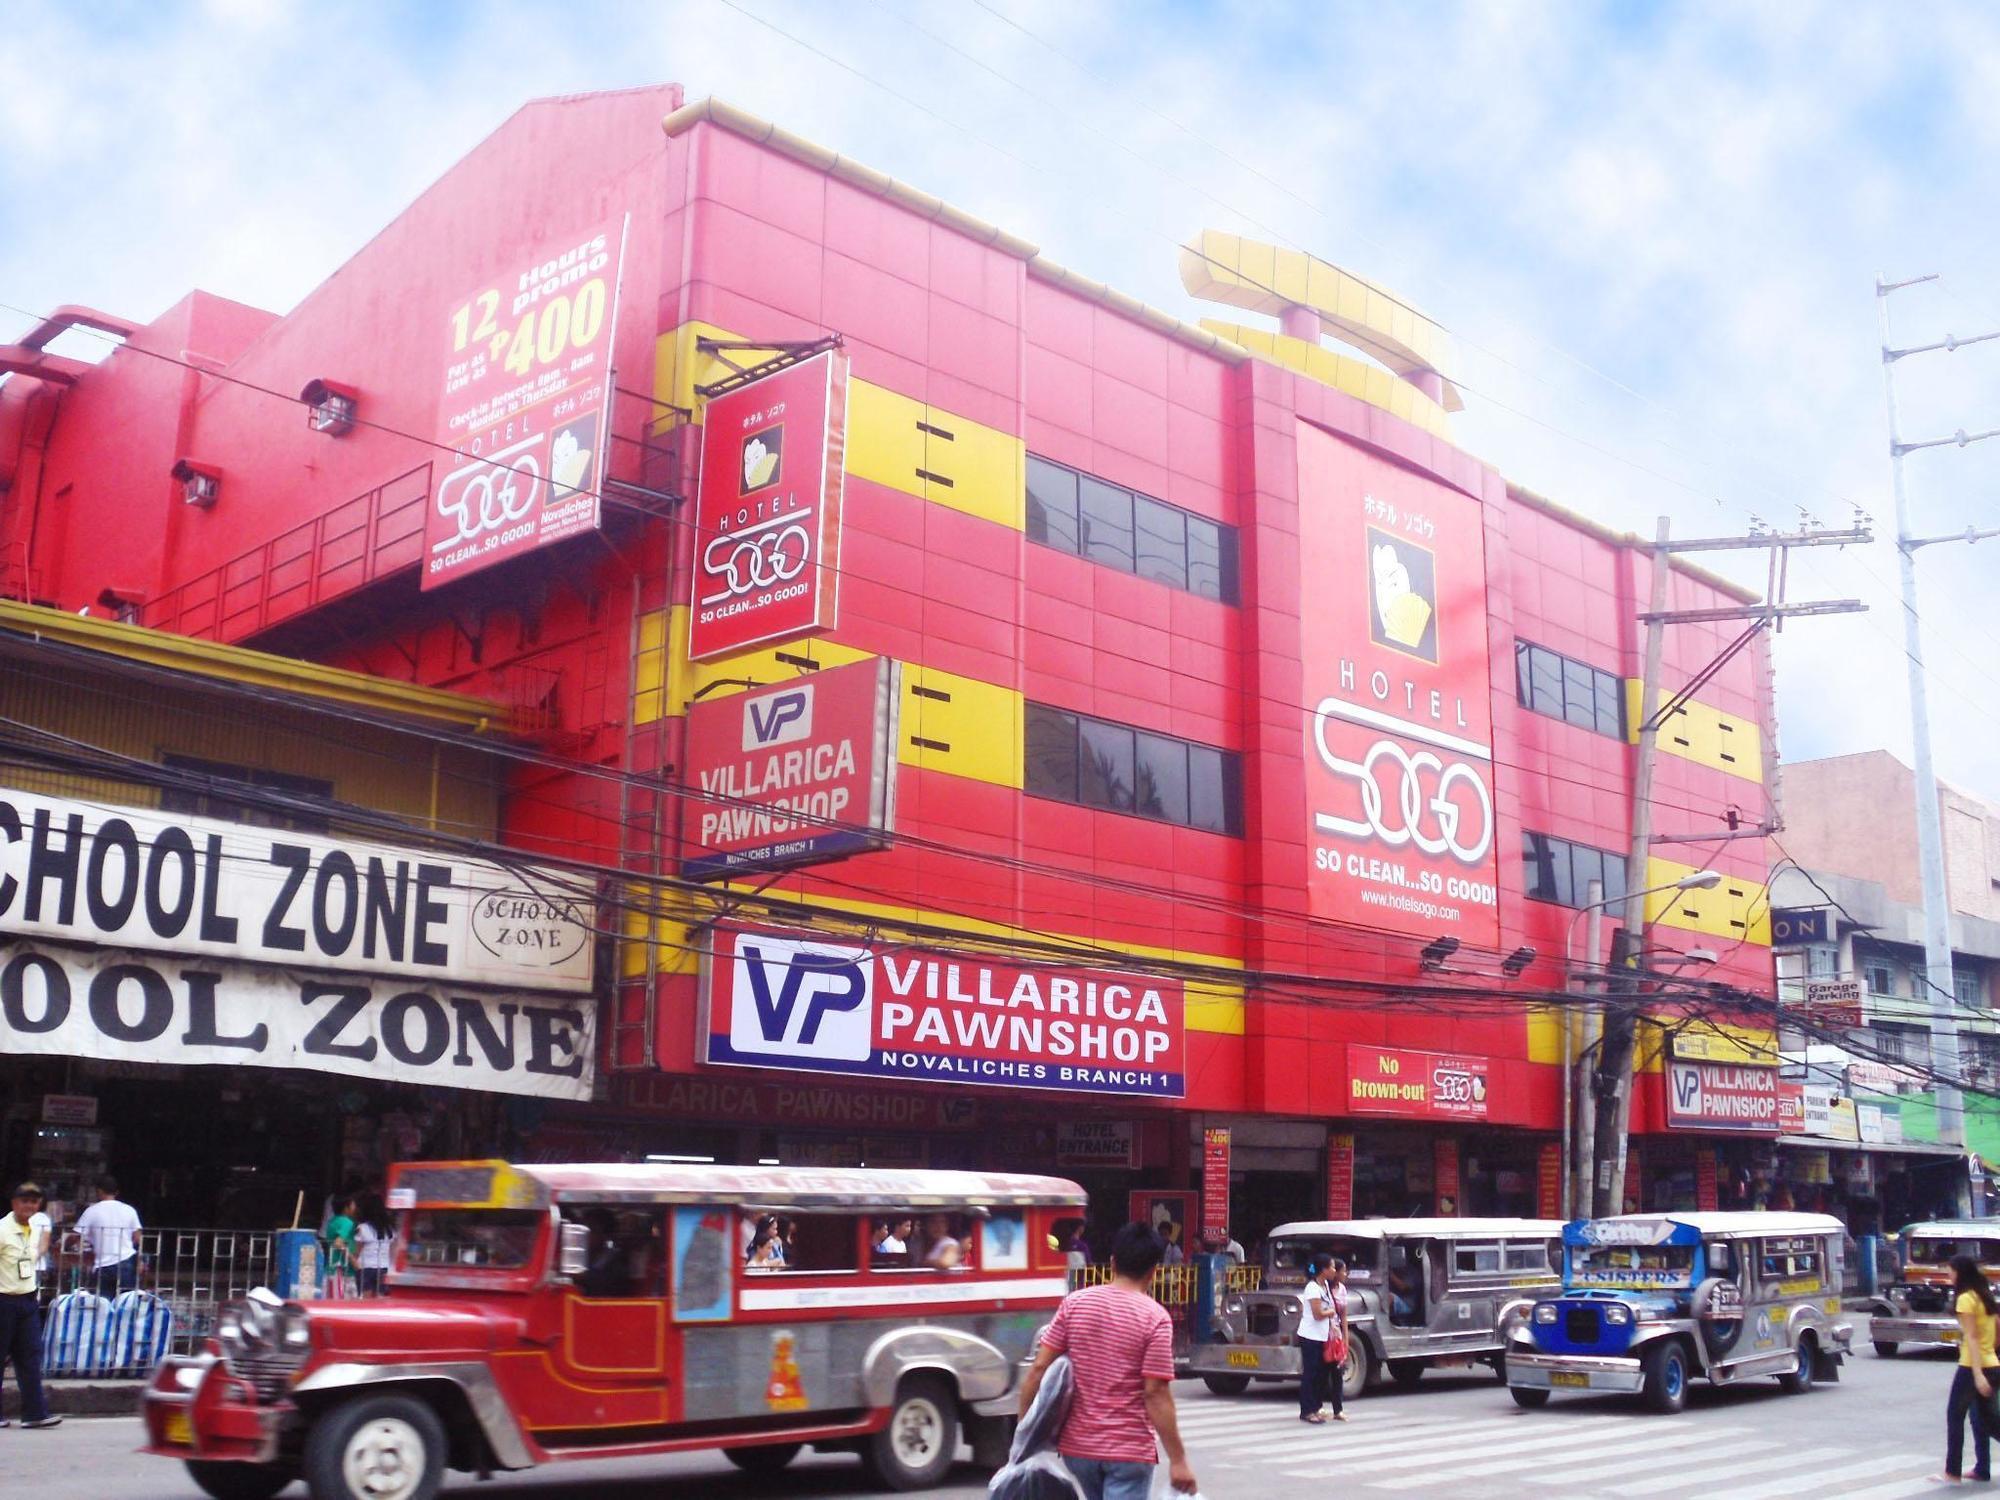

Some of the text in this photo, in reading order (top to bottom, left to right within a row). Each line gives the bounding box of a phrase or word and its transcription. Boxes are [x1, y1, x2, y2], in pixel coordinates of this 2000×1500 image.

[452, 289, 500, 352] 12
[455, 416, 529, 465] HOTEL
[433, 432, 545, 554] SOGO
[540, 498, 593, 525] Novaliches
[720, 492, 796, 531] HOTEL
[430, 557, 444, 573] SO
[501, 520, 535, 544] GOOD!
[702, 507, 811, 605] SOGO
[700, 611, 714, 624] SO
[774, 582, 808, 602] GOOD!
[1340, 658, 1467, 728] HOTEL
[750, 692, 806, 743] VP
[700, 740, 855, 804] VILLARICA
[1314, 697, 1492, 863] SOGO
[701, 787, 849, 846] PAWNSHOP
[775, 842, 806, 857] BRANCH
[1316, 847, 1341, 872] SO
[1447, 876, 1497, 906] GOOD!
[261, 842, 452, 967] ZONE
[483, 898, 577, 922] SCHOOL
[1361, 889, 1460, 921] www.hotelsogo.com
[496, 928, 562, 951] ZONE
[743, 947, 1168, 1045] VP VILLARICA
[1808, 982, 1858, 995] Garage
[1808, 991, 1860, 1002] Parking
[300, 980, 585, 1079] ZONE
[881, 1003, 1170, 1064] PAWNSHOP
[882, 1052, 1169, 1087] NOVALICHES BRANCH 1
[1379, 1055, 1399, 1075] No
[1434, 1068, 1471, 1102] SOGO
[776, 1087, 926, 1123] PAWNSHOP
[1352, 1079, 1425, 1101] Brown-out
[1674, 1066, 1775, 1108] VP VILLARICA
[1703, 1094, 1776, 1119] PAWNSHOP
[1058, 1138, 1129, 1154] ENTRANCE
[1073, 1123, 1117, 1137] HOTEL
